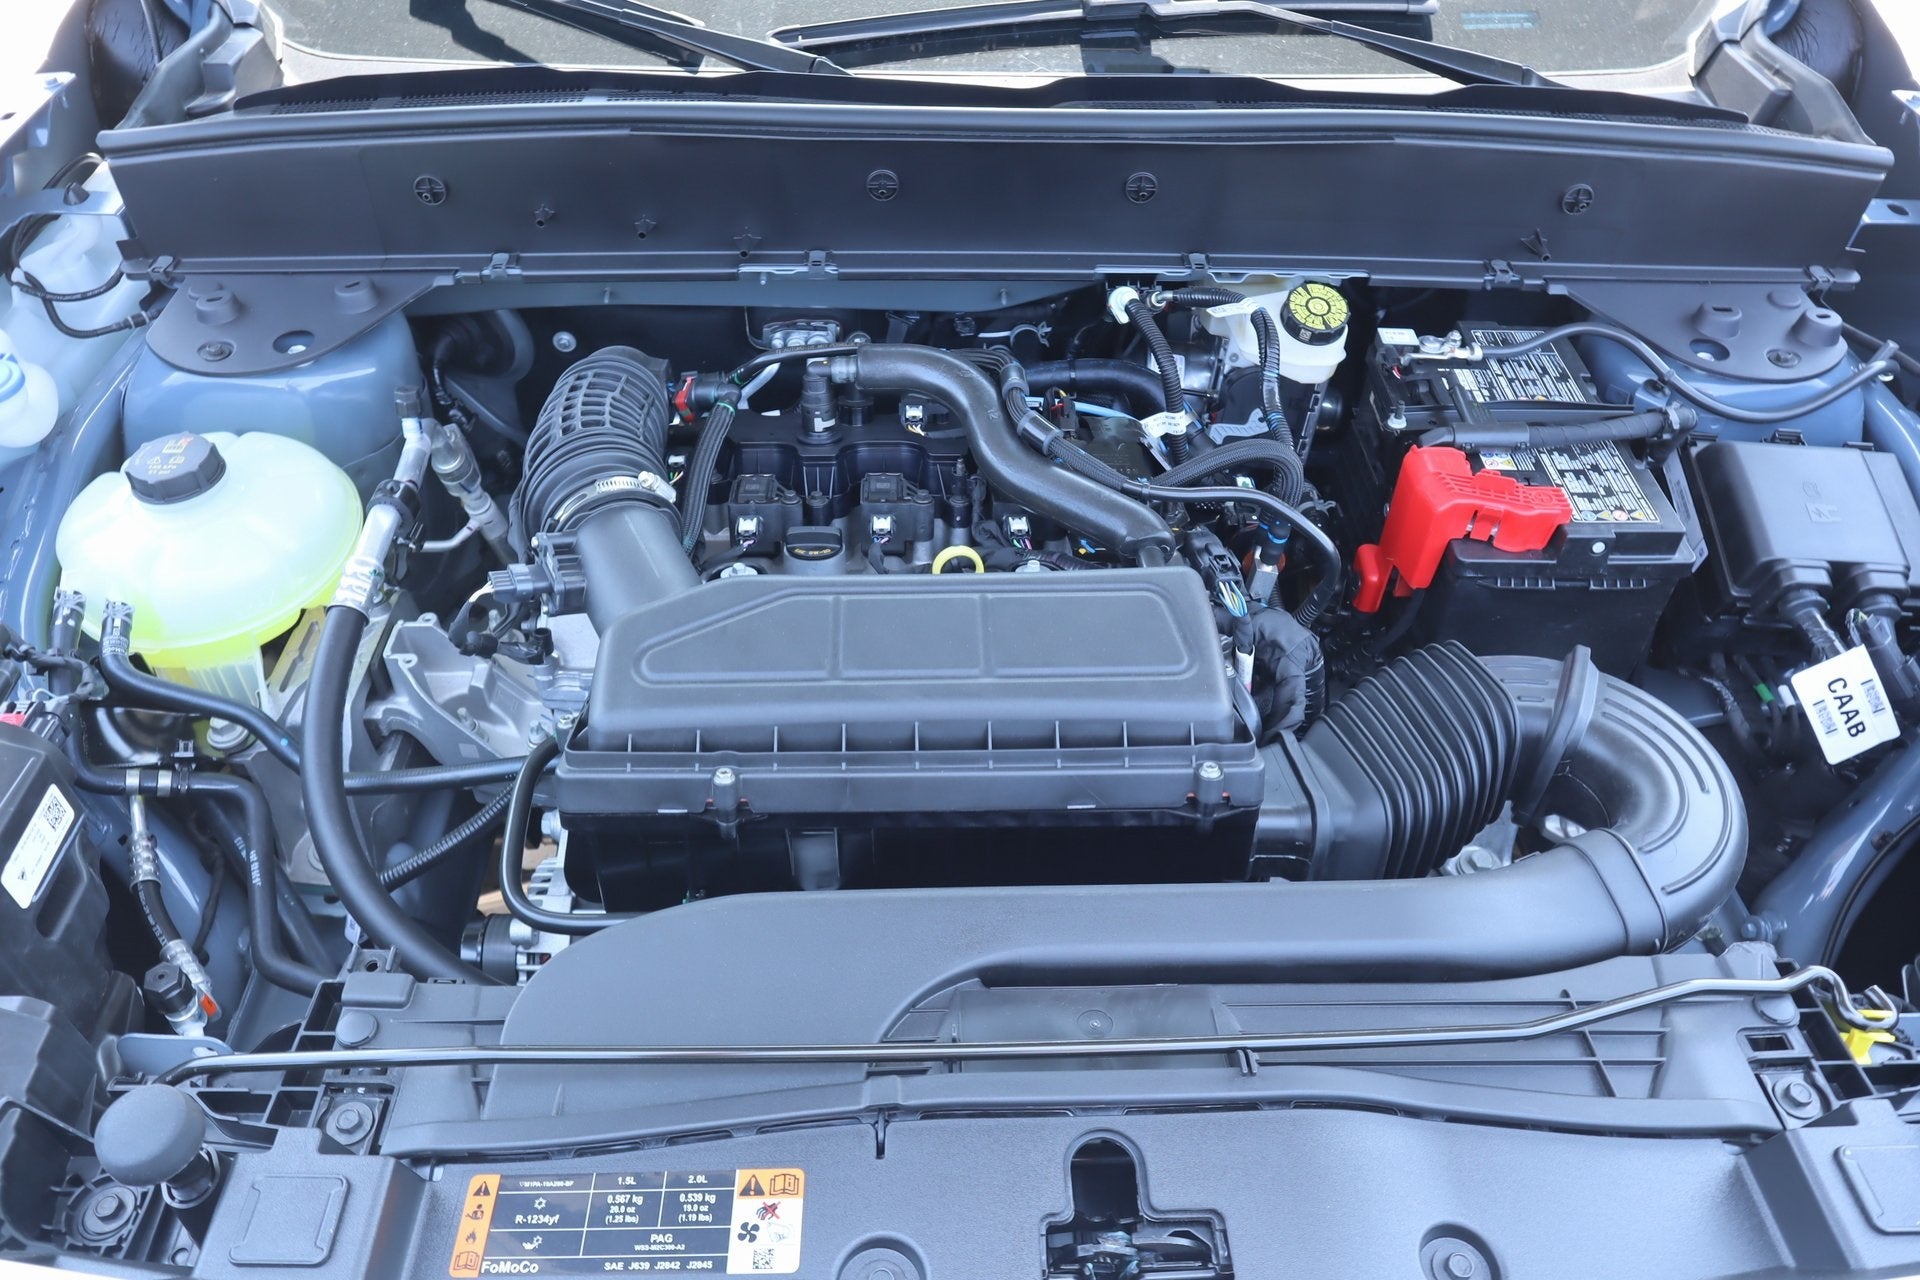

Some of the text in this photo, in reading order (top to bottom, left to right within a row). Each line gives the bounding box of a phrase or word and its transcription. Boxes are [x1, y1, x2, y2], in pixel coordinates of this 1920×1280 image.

[1827, 677, 1866, 738] CAAB
[617, 1176, 637, 1185] 1.5L
[687, 1175, 708, 1184] 2.0L
[606, 1194, 644, 1205] 0.567 kg
[679, 1193, 716, 1204] 0.539 kg
[683, 1204, 698, 1212] 19.0
[514, 1214, 560, 1226] R-1234yf
[625, 1215, 639, 1224] lbs)
[698, 1213, 713, 1223] lbs)
[650, 1233, 674, 1243] PAG
[480, 1260, 540, 1274] FoMoCo
[603, 1262, 624, 1271] SAE
[628, 1261, 650, 1271] J639
[686, 1260, 713, 1270] J2845
